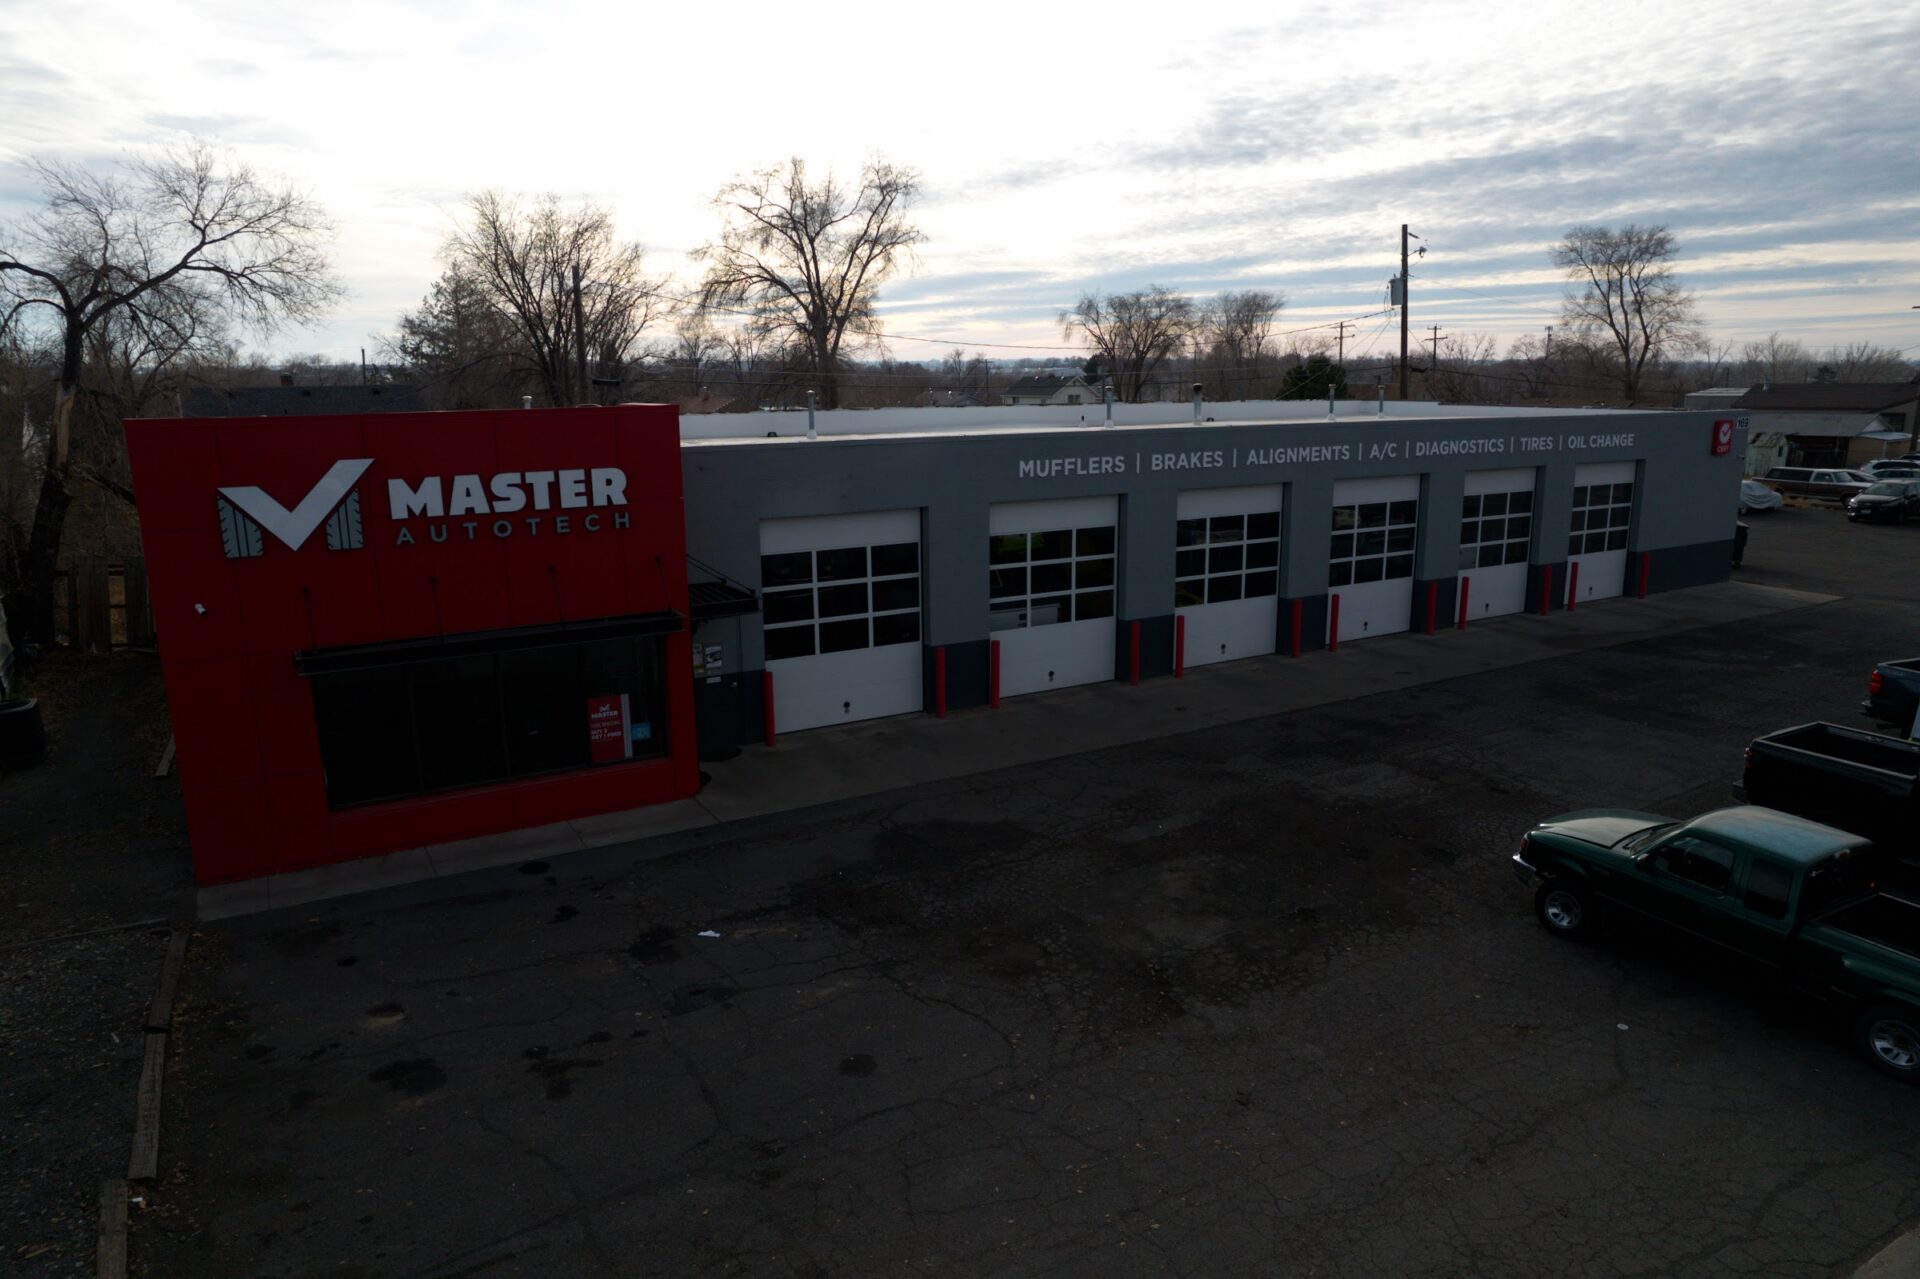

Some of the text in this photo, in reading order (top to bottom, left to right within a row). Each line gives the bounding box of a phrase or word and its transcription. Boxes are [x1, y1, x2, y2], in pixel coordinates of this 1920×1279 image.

[1018, 433, 1635, 478] MUFFLERS BRAKES ALIGNMENTS A/C DIAGNOSTICS TIRES OIL CHANGE
[387, 467, 628, 520] MASTER
[397, 511, 631, 546] AUTOTECH
